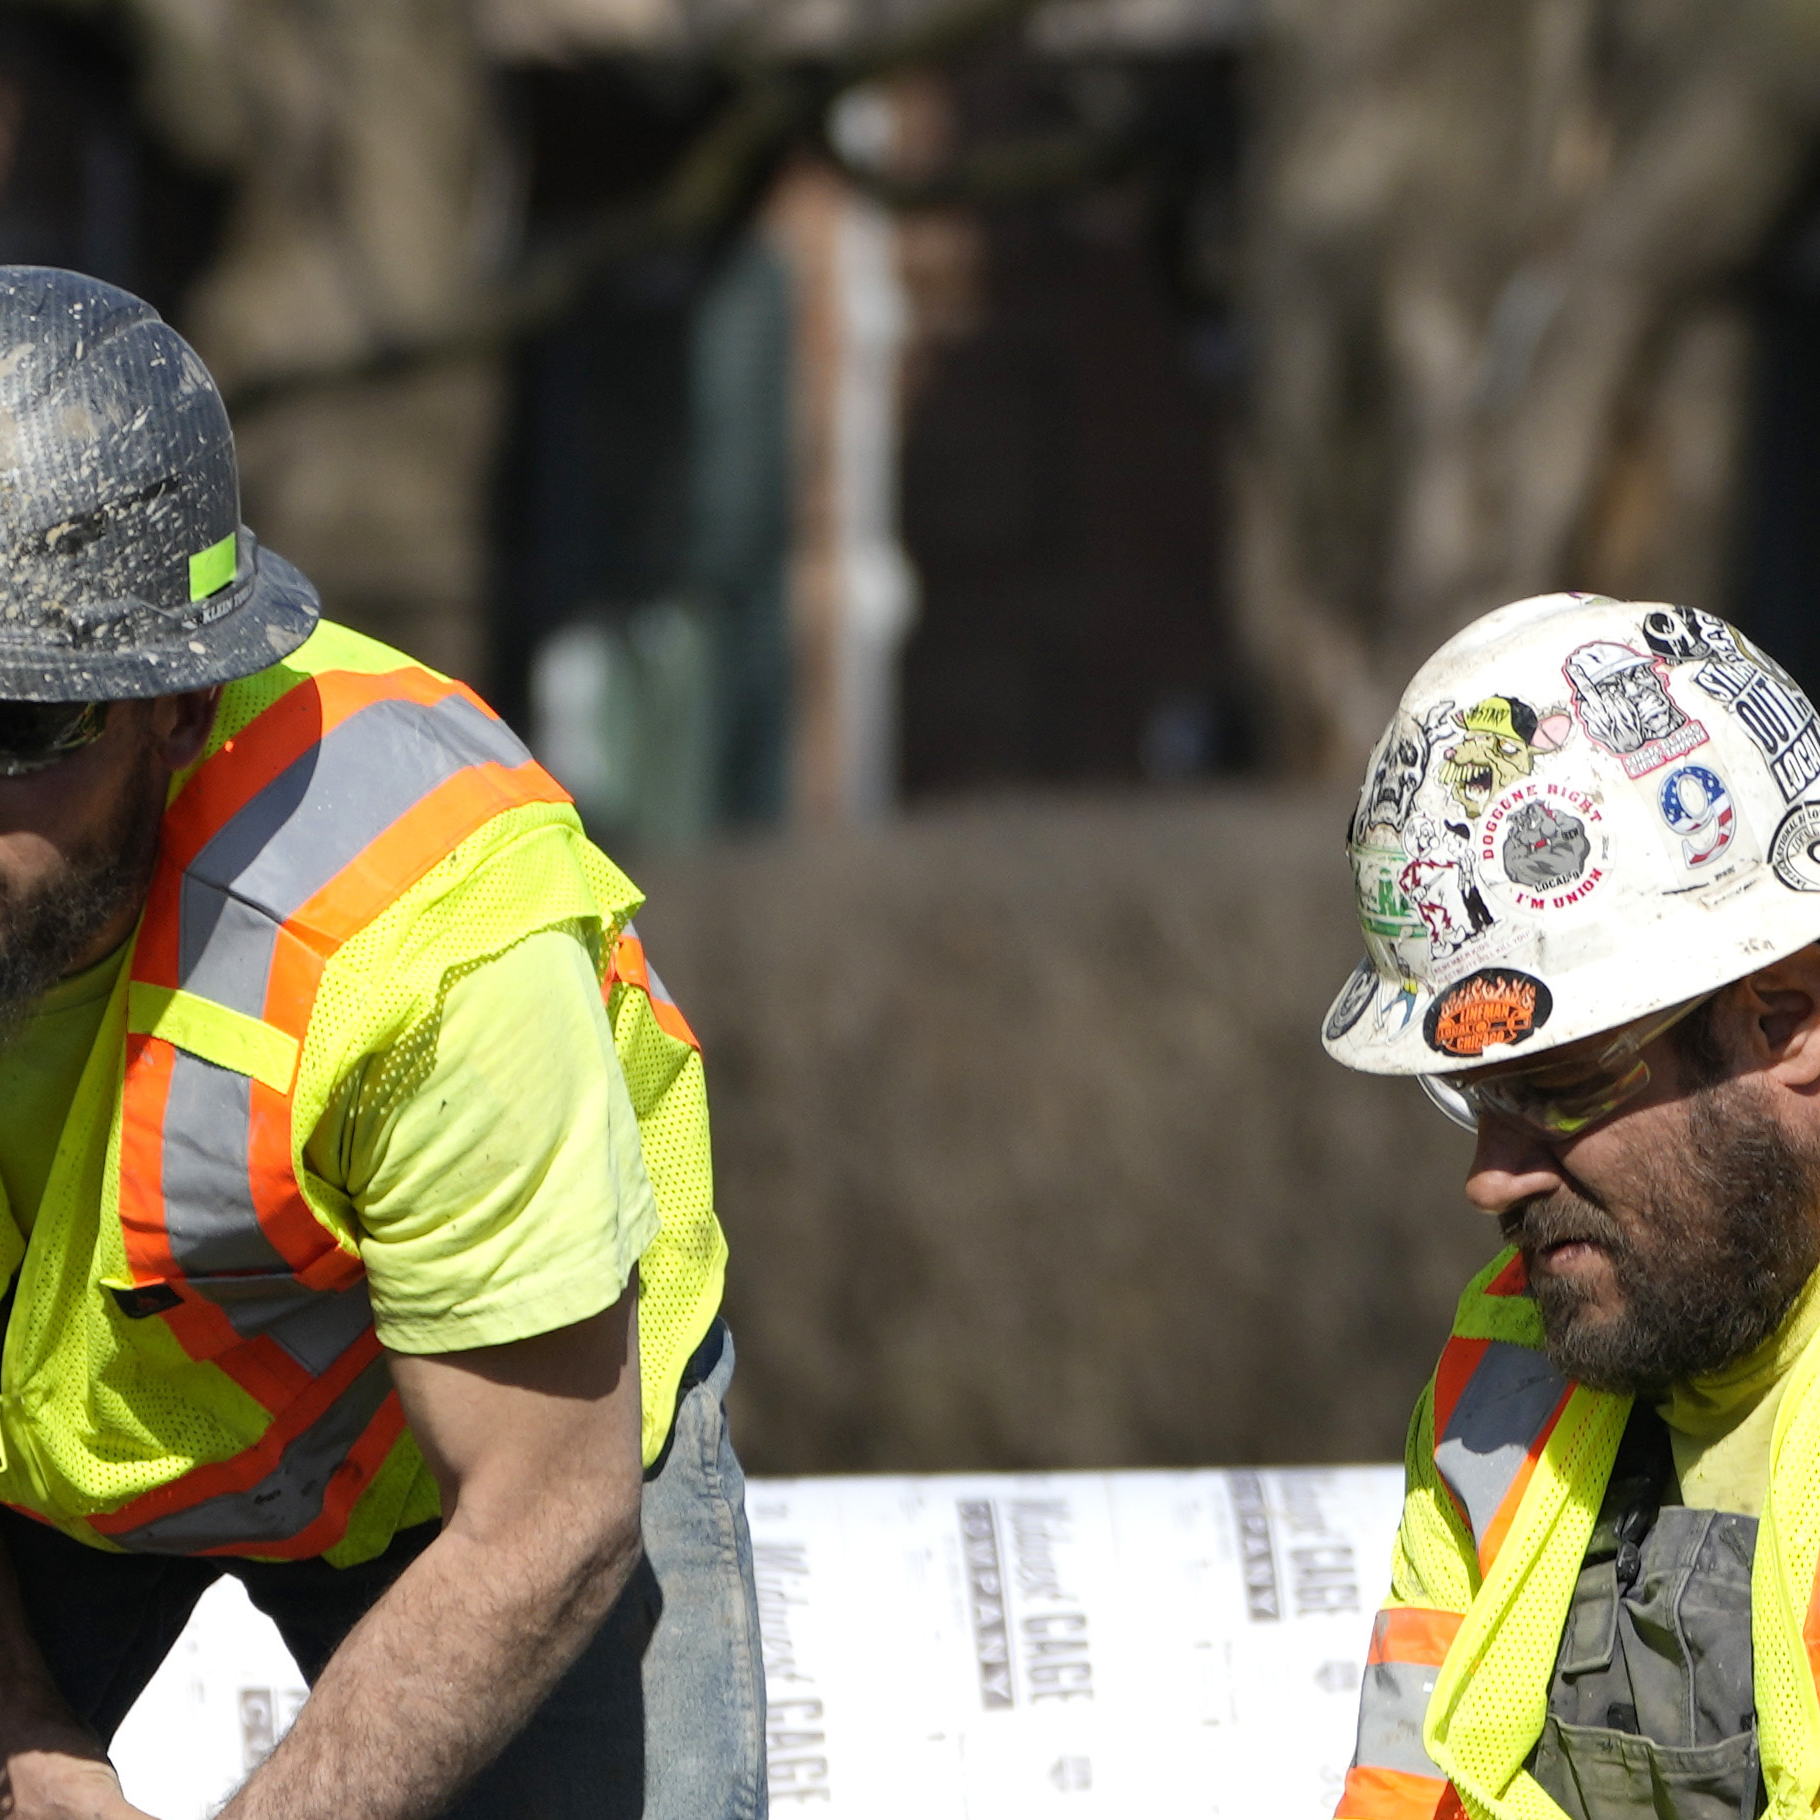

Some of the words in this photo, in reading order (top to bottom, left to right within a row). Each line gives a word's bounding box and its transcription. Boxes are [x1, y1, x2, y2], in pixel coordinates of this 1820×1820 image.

[1547, 783, 1603, 823] RIGHT
[1657, 764, 1738, 869] 9
[1515, 893, 1544, 910] I'M
[1552, 867, 1603, 909] UNION
[1460, 1003, 1510, 1021] LINEMAN
[1457, 1030, 1506, 1050] CHICAGO
[1021, 1613, 1096, 1705] GAGE
